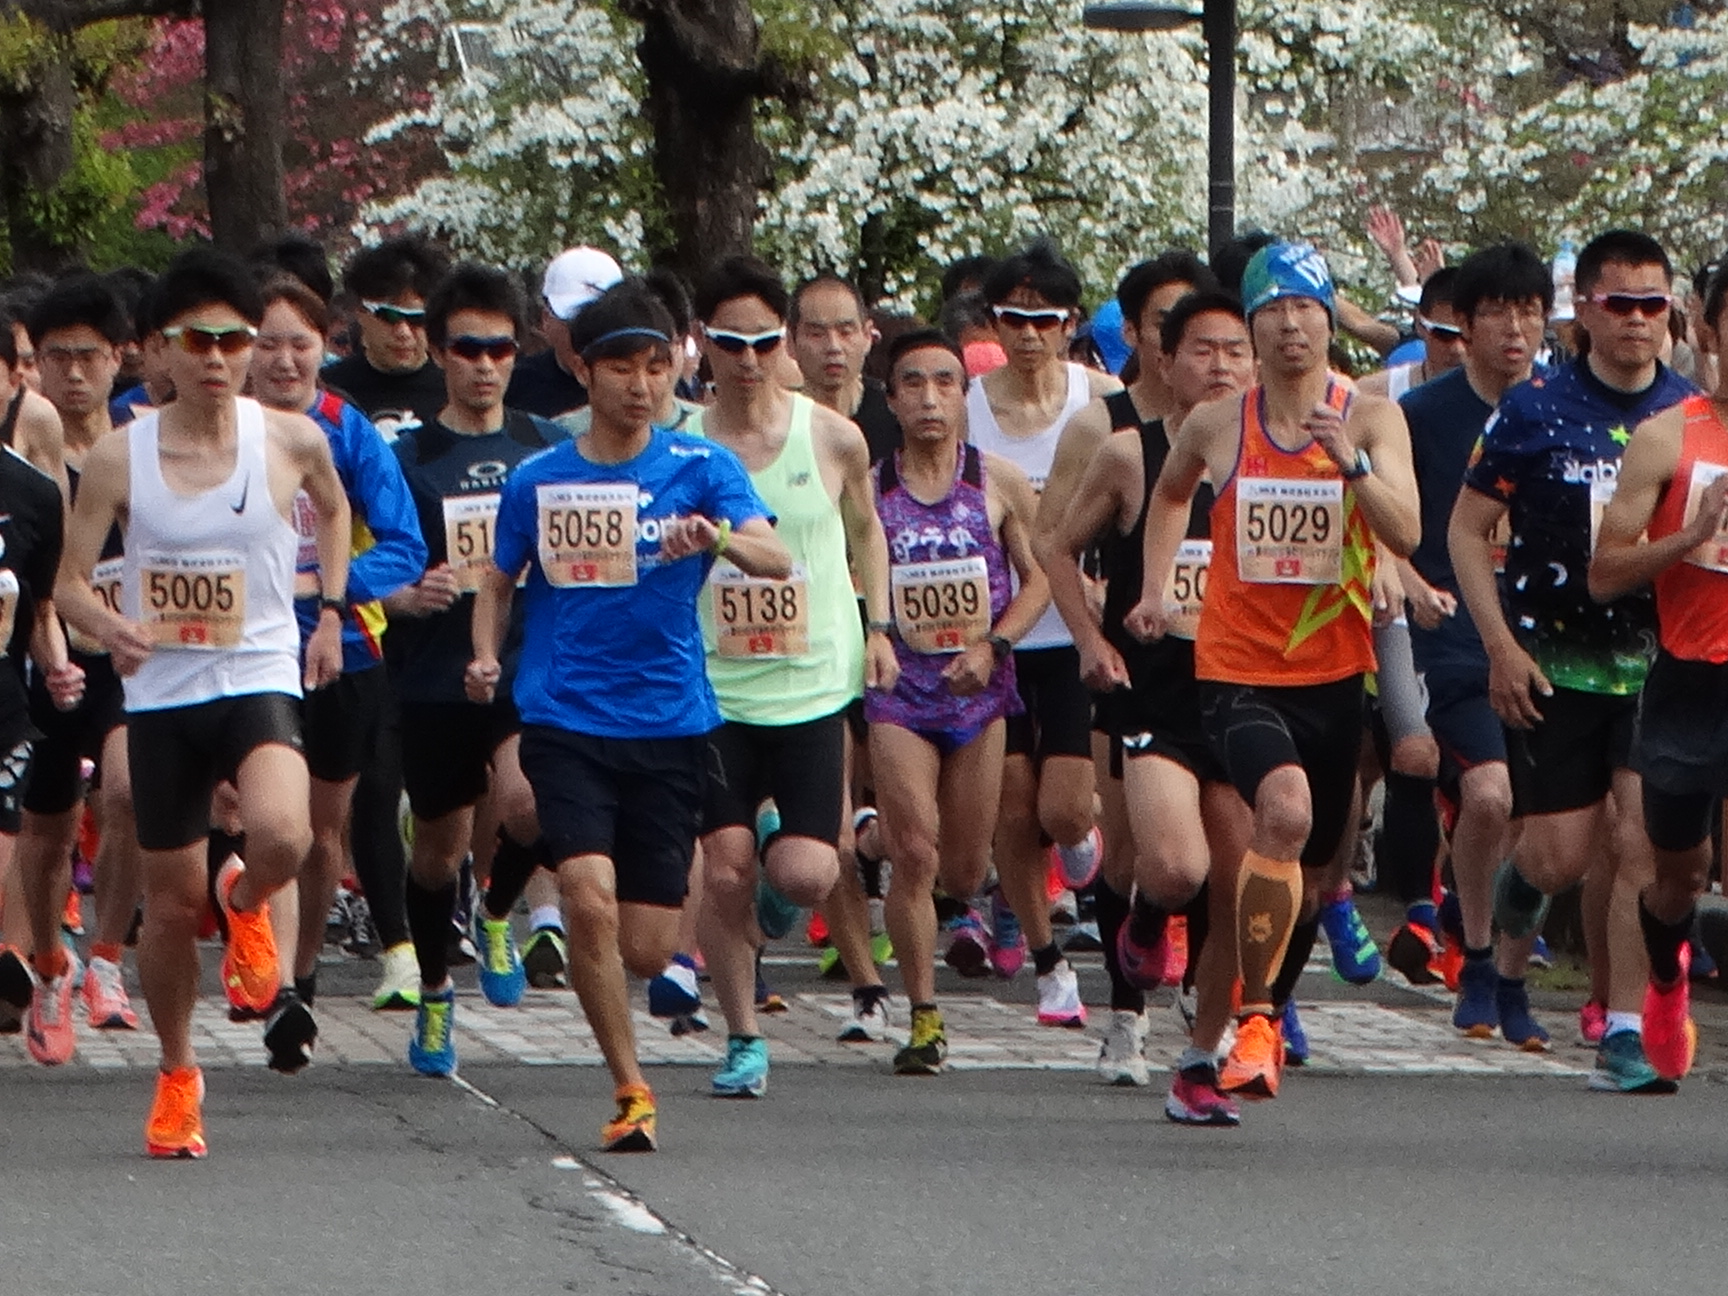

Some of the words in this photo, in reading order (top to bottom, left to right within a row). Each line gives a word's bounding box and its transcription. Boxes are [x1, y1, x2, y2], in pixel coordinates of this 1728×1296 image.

[455, 520, 491, 556] 51
[547, 510, 623, 548] 5058
[1247, 503, 1330, 544] 5029
[150, 572, 235, 612] 5005
[903, 581, 979, 621] 5039
[1173, 565, 1208, 602] 50
[721, 586, 797, 623] 5138
